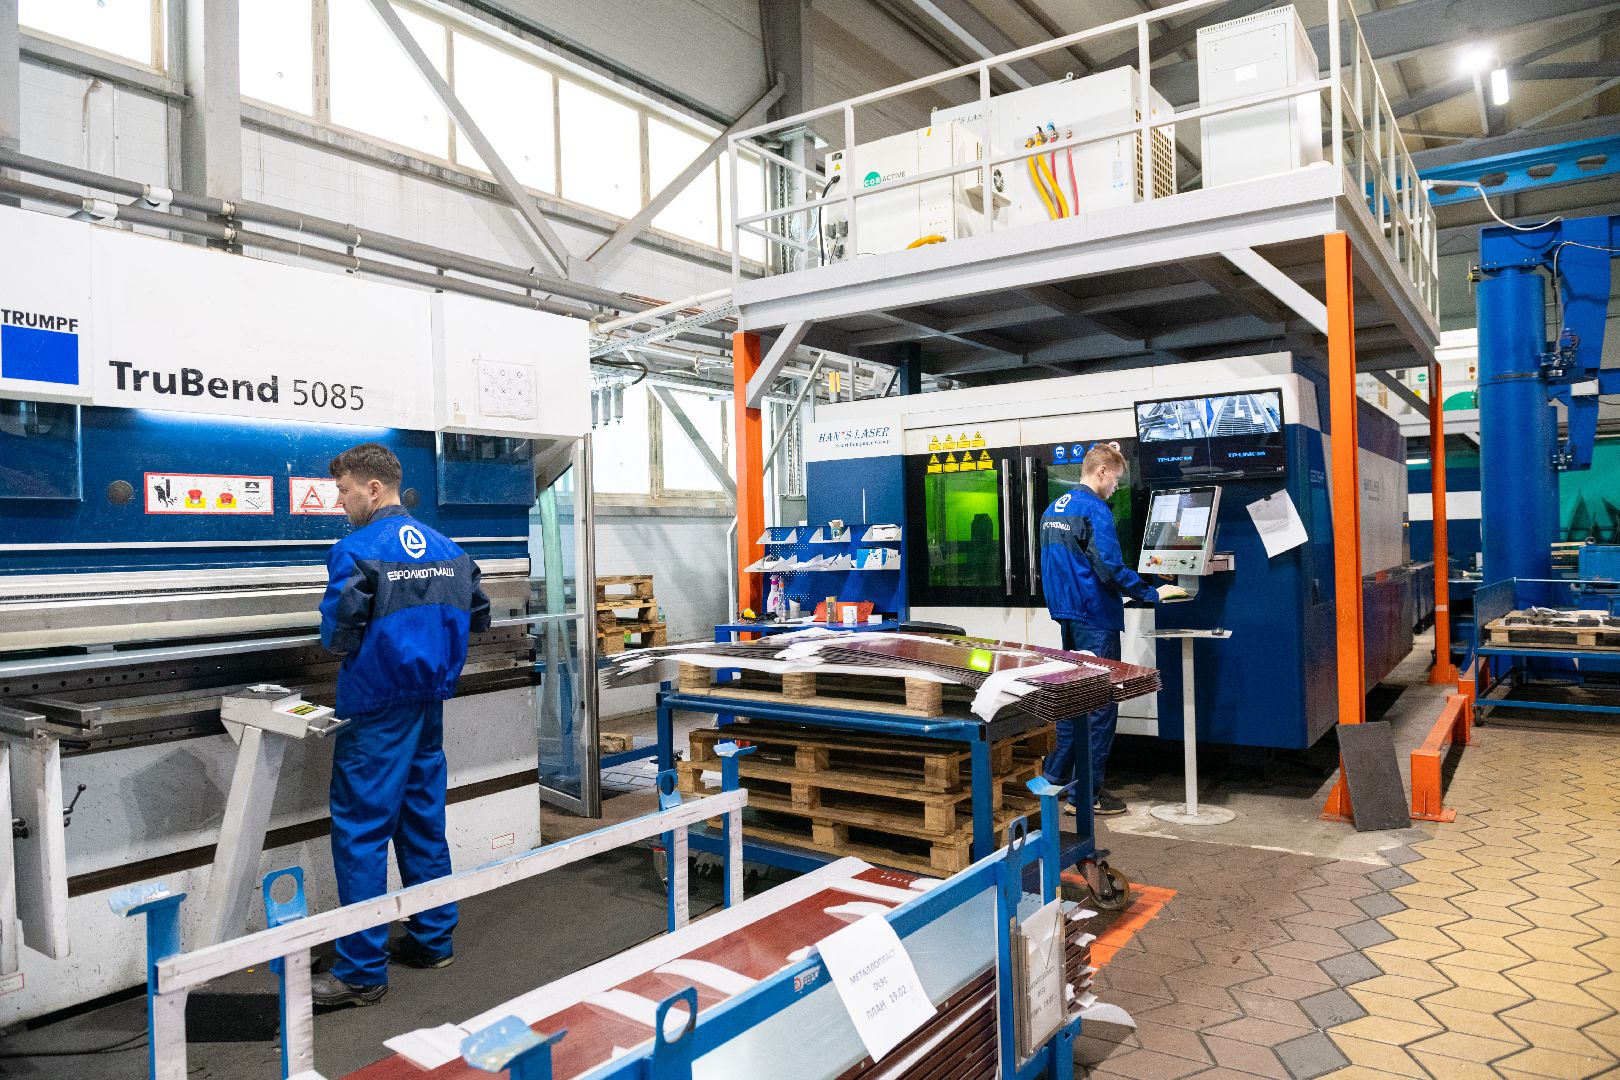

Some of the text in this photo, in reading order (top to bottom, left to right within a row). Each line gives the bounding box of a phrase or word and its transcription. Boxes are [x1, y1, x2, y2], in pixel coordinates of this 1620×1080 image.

[1, 308, 79, 332] TRUMPF
[108, 360, 364, 411] TruBend 5085
[854, 426, 890, 439] LASER
[866, 999, 887, 1021] ПЛАН
